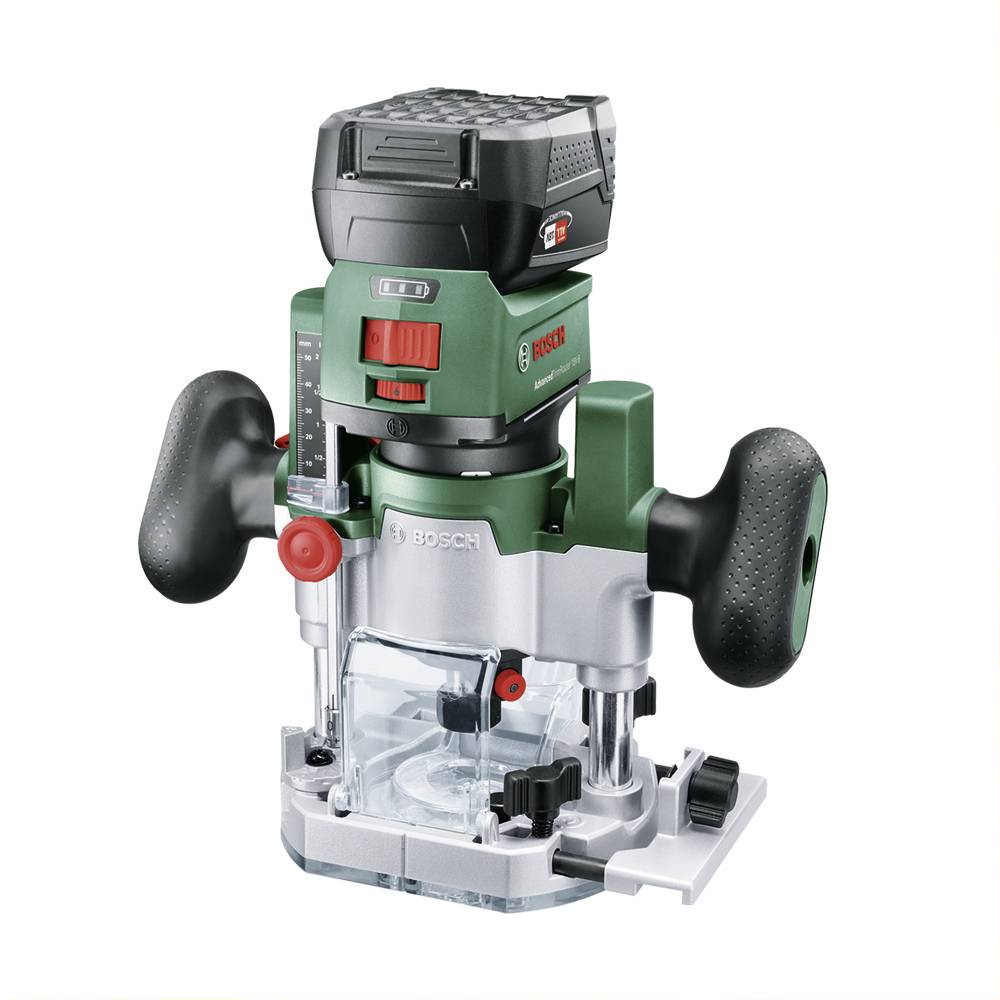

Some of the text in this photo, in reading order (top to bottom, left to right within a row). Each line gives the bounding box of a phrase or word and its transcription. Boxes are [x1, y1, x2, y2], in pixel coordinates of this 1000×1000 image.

[299, 340, 312, 348] mm
[532, 324, 565, 361] BOSCH
[413, 529, 480, 551] BOSCH
